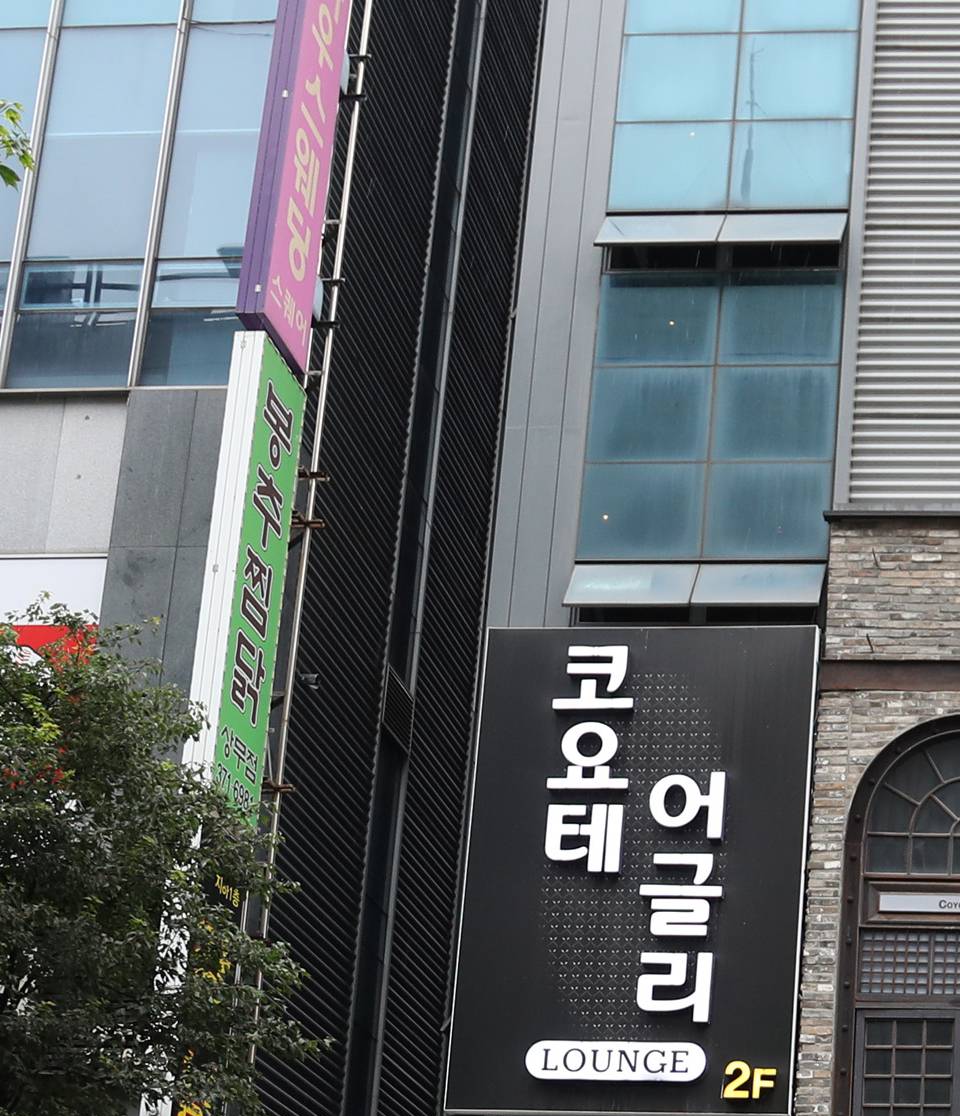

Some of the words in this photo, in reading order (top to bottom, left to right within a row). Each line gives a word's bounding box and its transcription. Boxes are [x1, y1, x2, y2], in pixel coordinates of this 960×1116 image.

[286, 0, 343, 282] 우스웨딩
[230, 378, 294, 728] 봉추찜닭
[221, 724, 258, 785] 상무점
[544, 645, 635, 873] 코요테
[636, 770, 727, 1023] 어글리
[540, 1047, 690, 1075] LOUNGE
[722, 1061, 777, 1100] 2F
